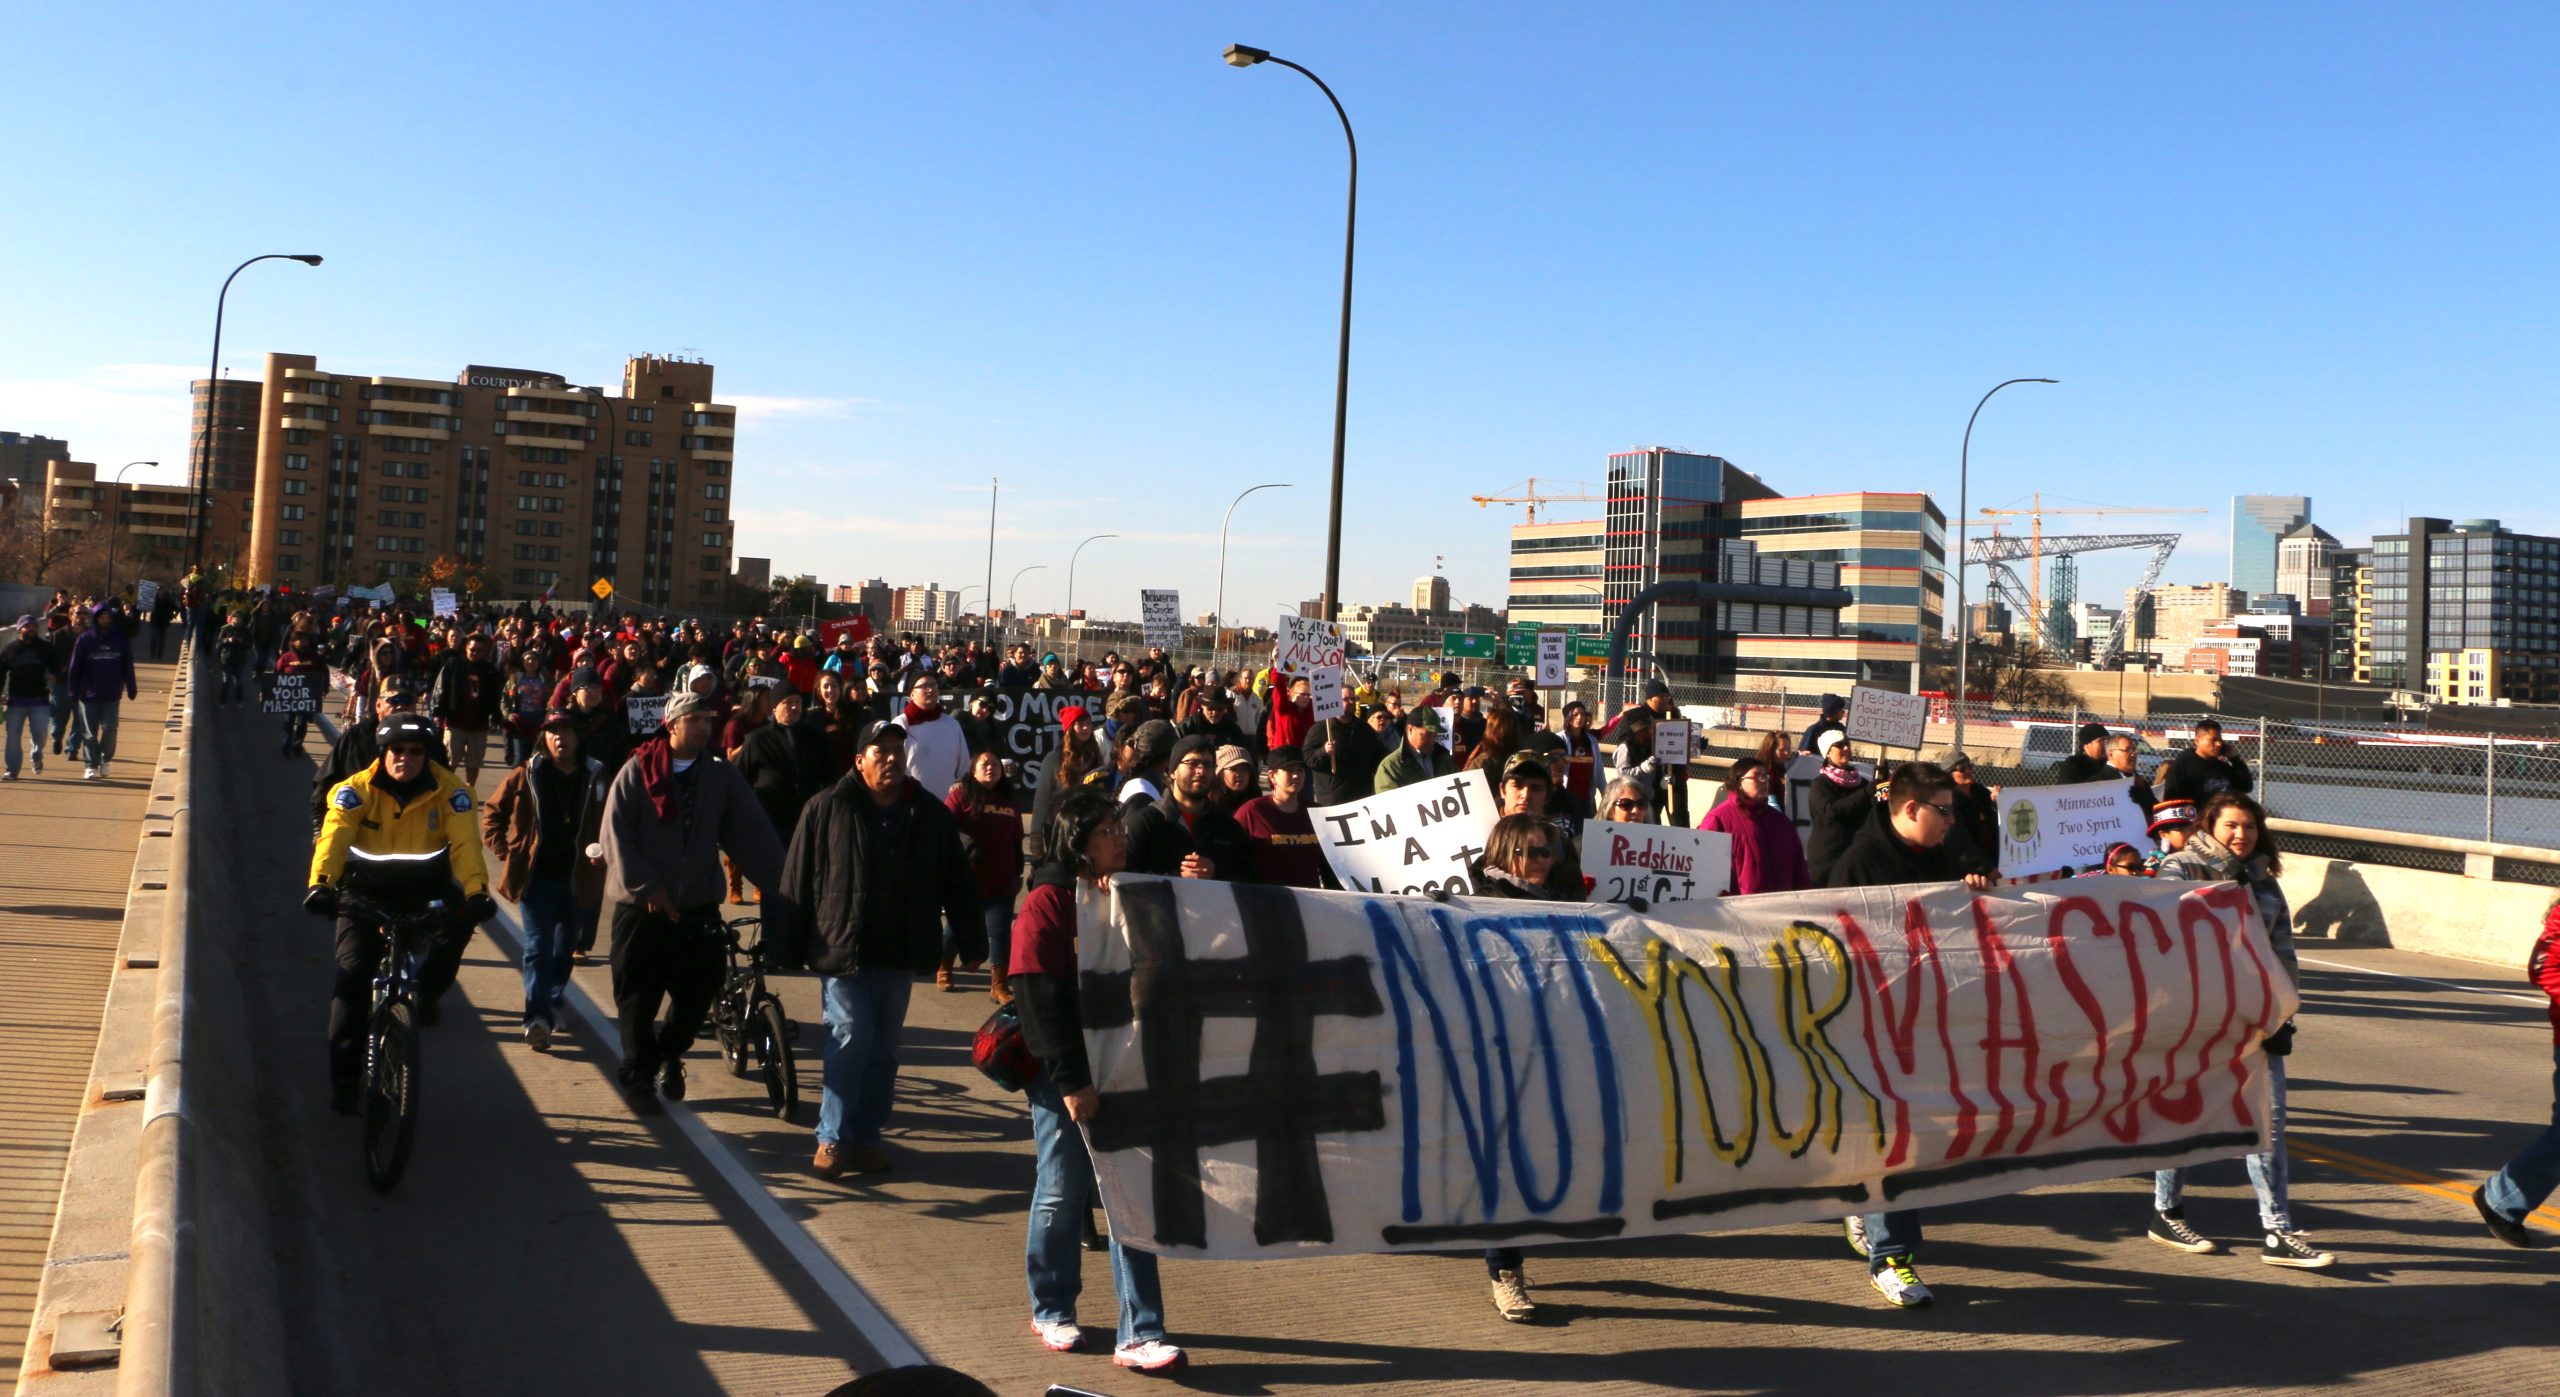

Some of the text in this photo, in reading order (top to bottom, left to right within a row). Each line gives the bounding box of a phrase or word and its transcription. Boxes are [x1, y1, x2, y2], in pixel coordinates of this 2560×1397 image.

[1288, 617, 1305, 631] WE
[1580, 642, 1611, 650] Washingt
[1285, 643, 1345, 669] MASCOT
[277, 675, 306, 687] NOT
[272, 687, 310, 700] YOUR
[262, 699, 317, 713] MASCOT!
[1317, 701, 1339, 712] PEACE
[1856, 704, 1884, 717] noun
[2055, 795, 2116, 812] Minnesota
[2057, 816, 2122, 837] Two Spirit
[1403, 836, 1431, 866] A
[2072, 842, 2110, 857] Societ
